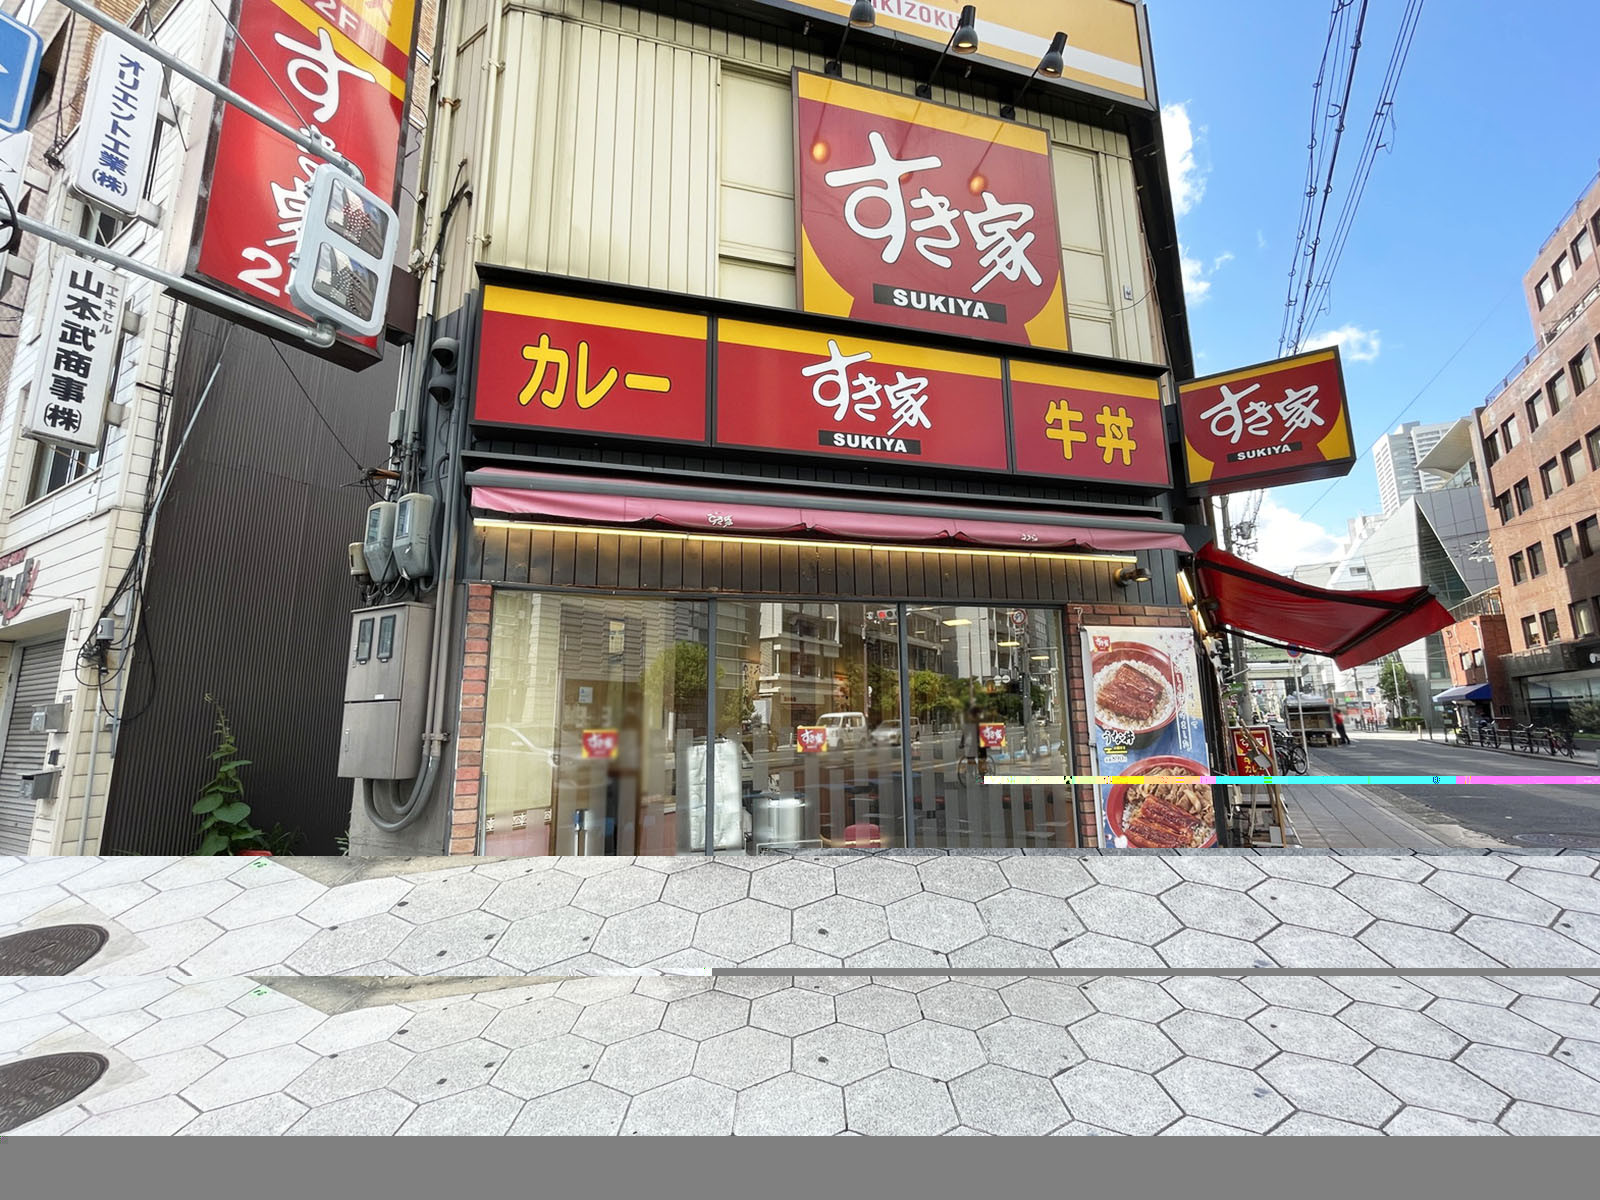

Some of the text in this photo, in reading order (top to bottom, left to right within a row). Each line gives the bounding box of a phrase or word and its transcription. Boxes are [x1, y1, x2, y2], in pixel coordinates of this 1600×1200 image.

[314, 0, 359, 30] 2F
[92, 54, 145, 197] オリエント工業(株)
[824, 130, 1043, 294] すき家
[99, 284, 120, 335] エキセル
[893, 288, 990, 320] SUKIYA
[43, 270, 105, 433] 山本武商事(株)
[518, 332, 672, 409] カレー
[801, 339, 932, 436] すき家
[1200, 383, 1325, 444] すき家
[833, 432, 909, 454] SUKIYA
[1045, 399, 1137, 467] 牛丼
[1237, 443, 1292, 461] SUKIYA
